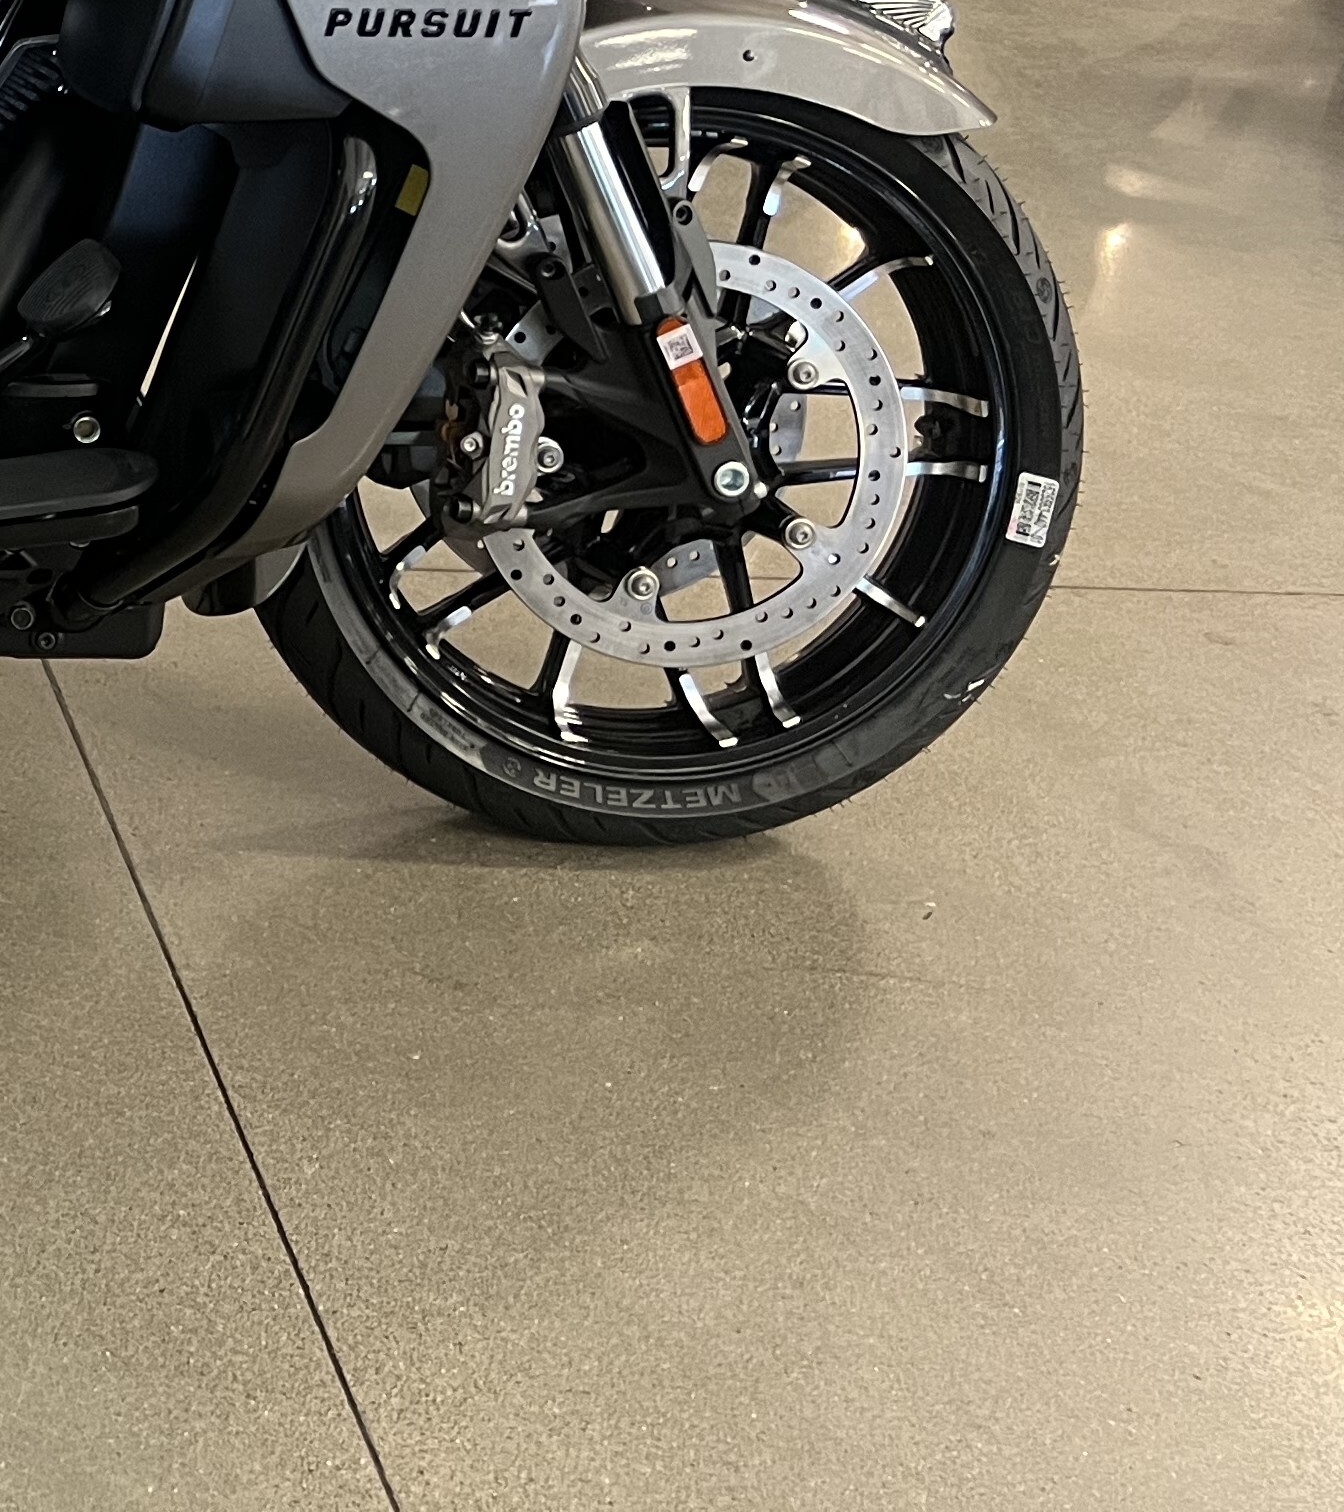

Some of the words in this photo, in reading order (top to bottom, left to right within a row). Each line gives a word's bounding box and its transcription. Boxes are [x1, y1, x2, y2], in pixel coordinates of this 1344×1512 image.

[323, 7, 533, 38] PURSUIT
[493, 403, 525, 496] brembo
[532, 767, 743, 810] METZELER
